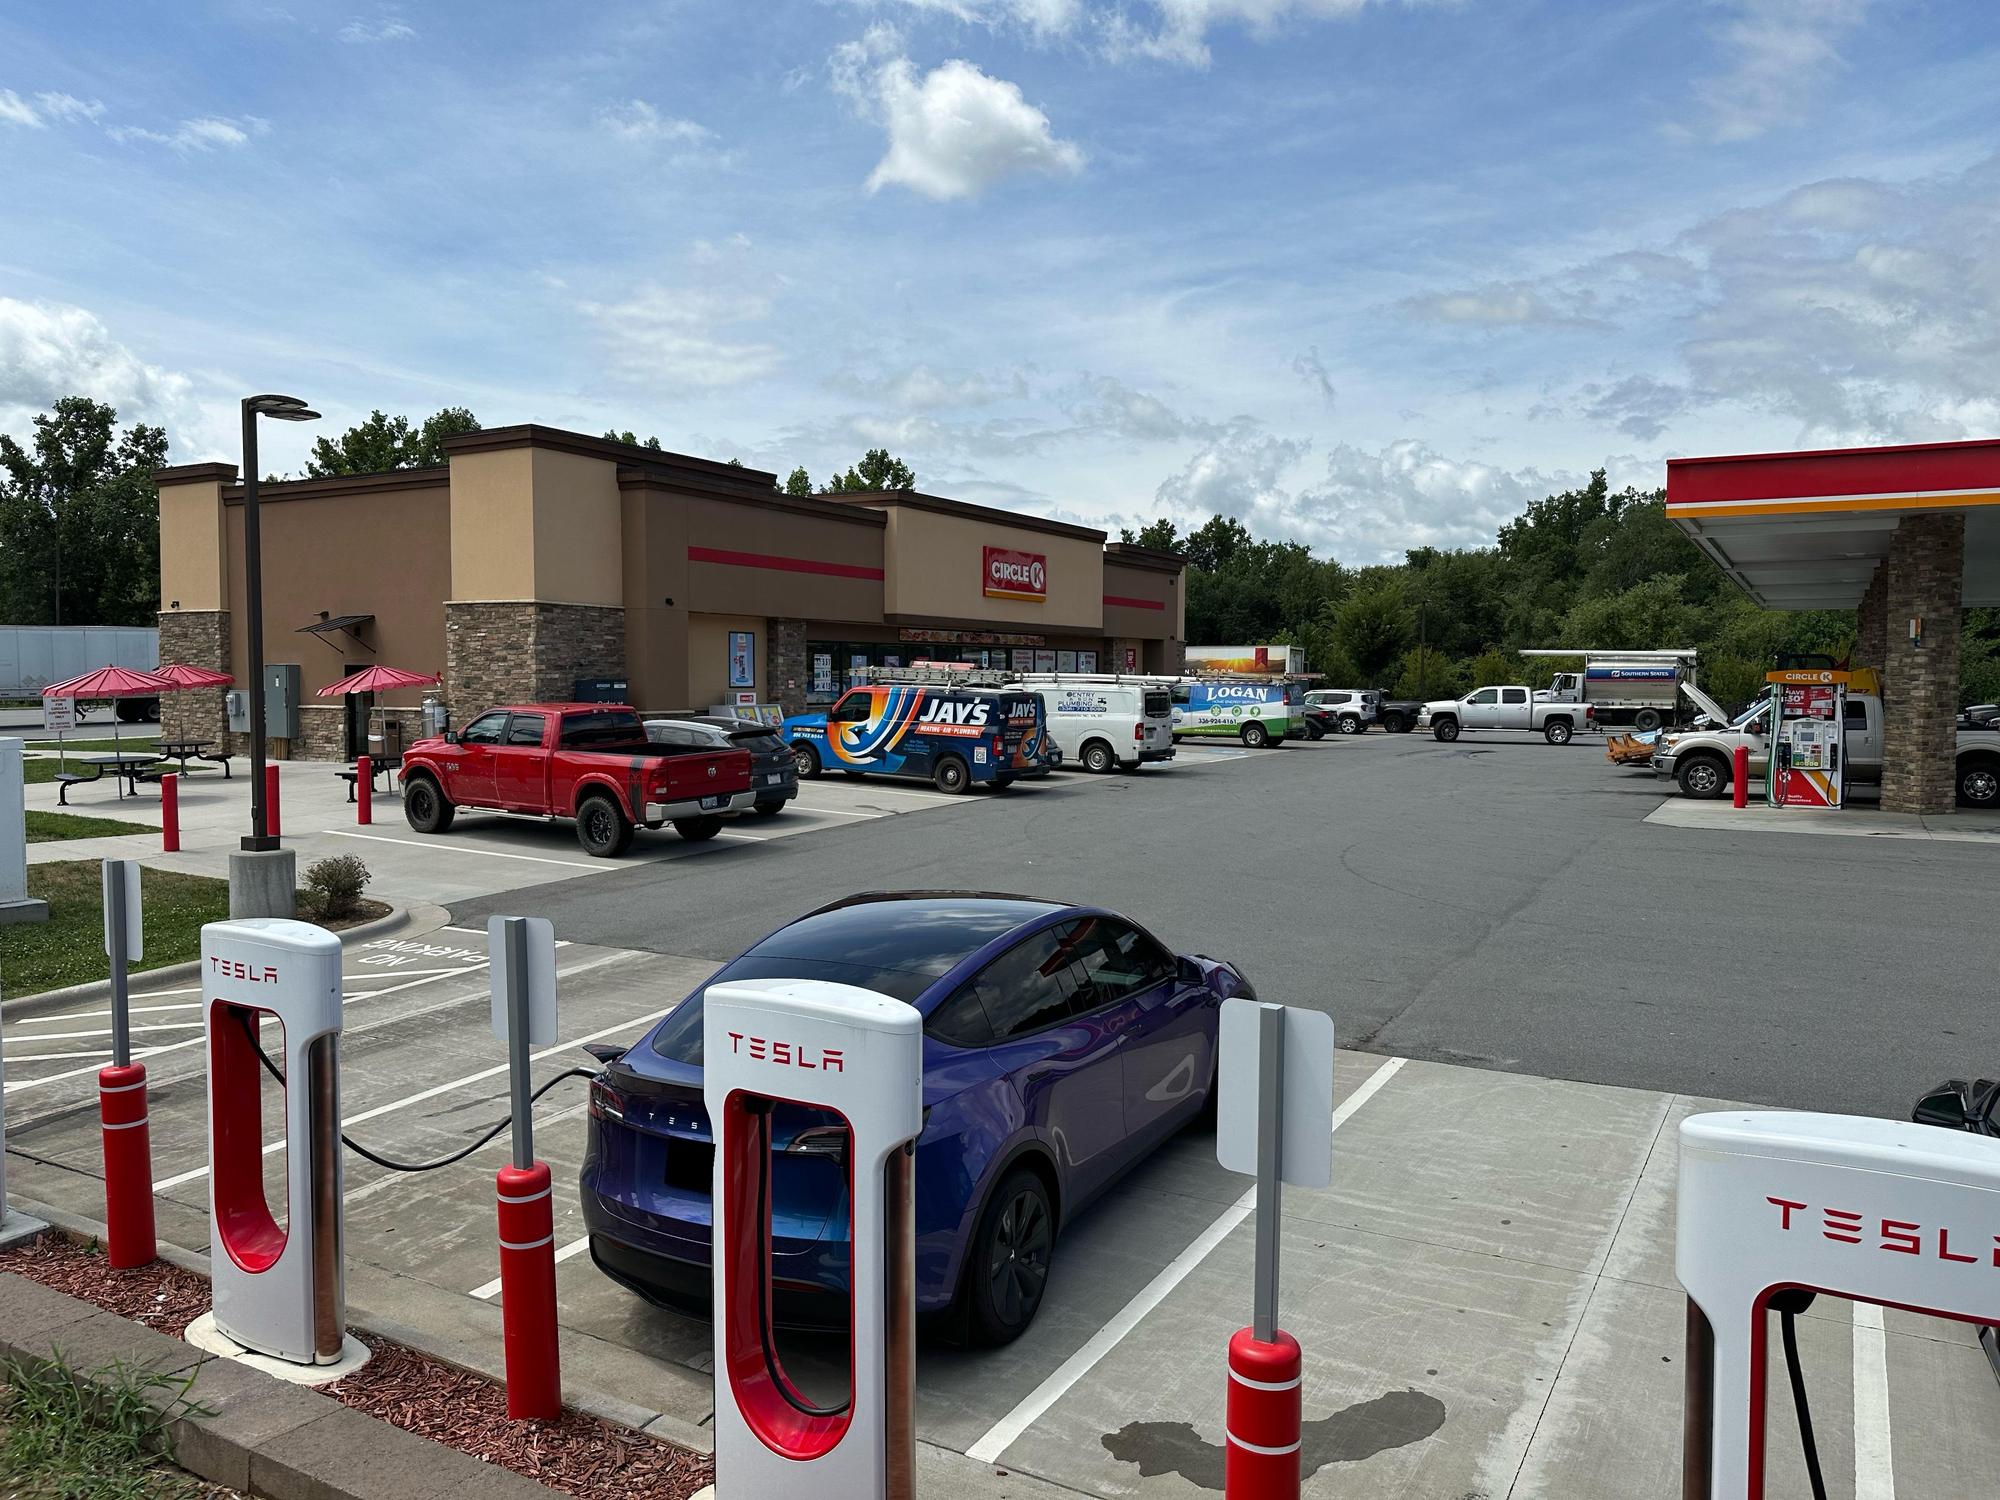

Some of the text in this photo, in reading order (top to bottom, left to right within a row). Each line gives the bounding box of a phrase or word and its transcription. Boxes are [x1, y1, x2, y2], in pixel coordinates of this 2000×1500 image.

[991, 561, 1043, 586] CIRCLE K
[1785, 673, 1818, 681] CIRCLE
[1206, 687, 1268, 702] LOGAN
[919, 697, 990, 725] JAY'S
[1008, 699, 1036, 717] JAY'S
[920, 725, 940, 733] HEATING
[358, 953, 418, 967] NO
[361, 939, 491, 962] PARKING
[210, 956, 278, 984] TESLA
[728, 1031, 844, 1073] TESLA
[648, 1112, 698, 1130] TES
[1765, 1196, 2000, 1268] TESL
